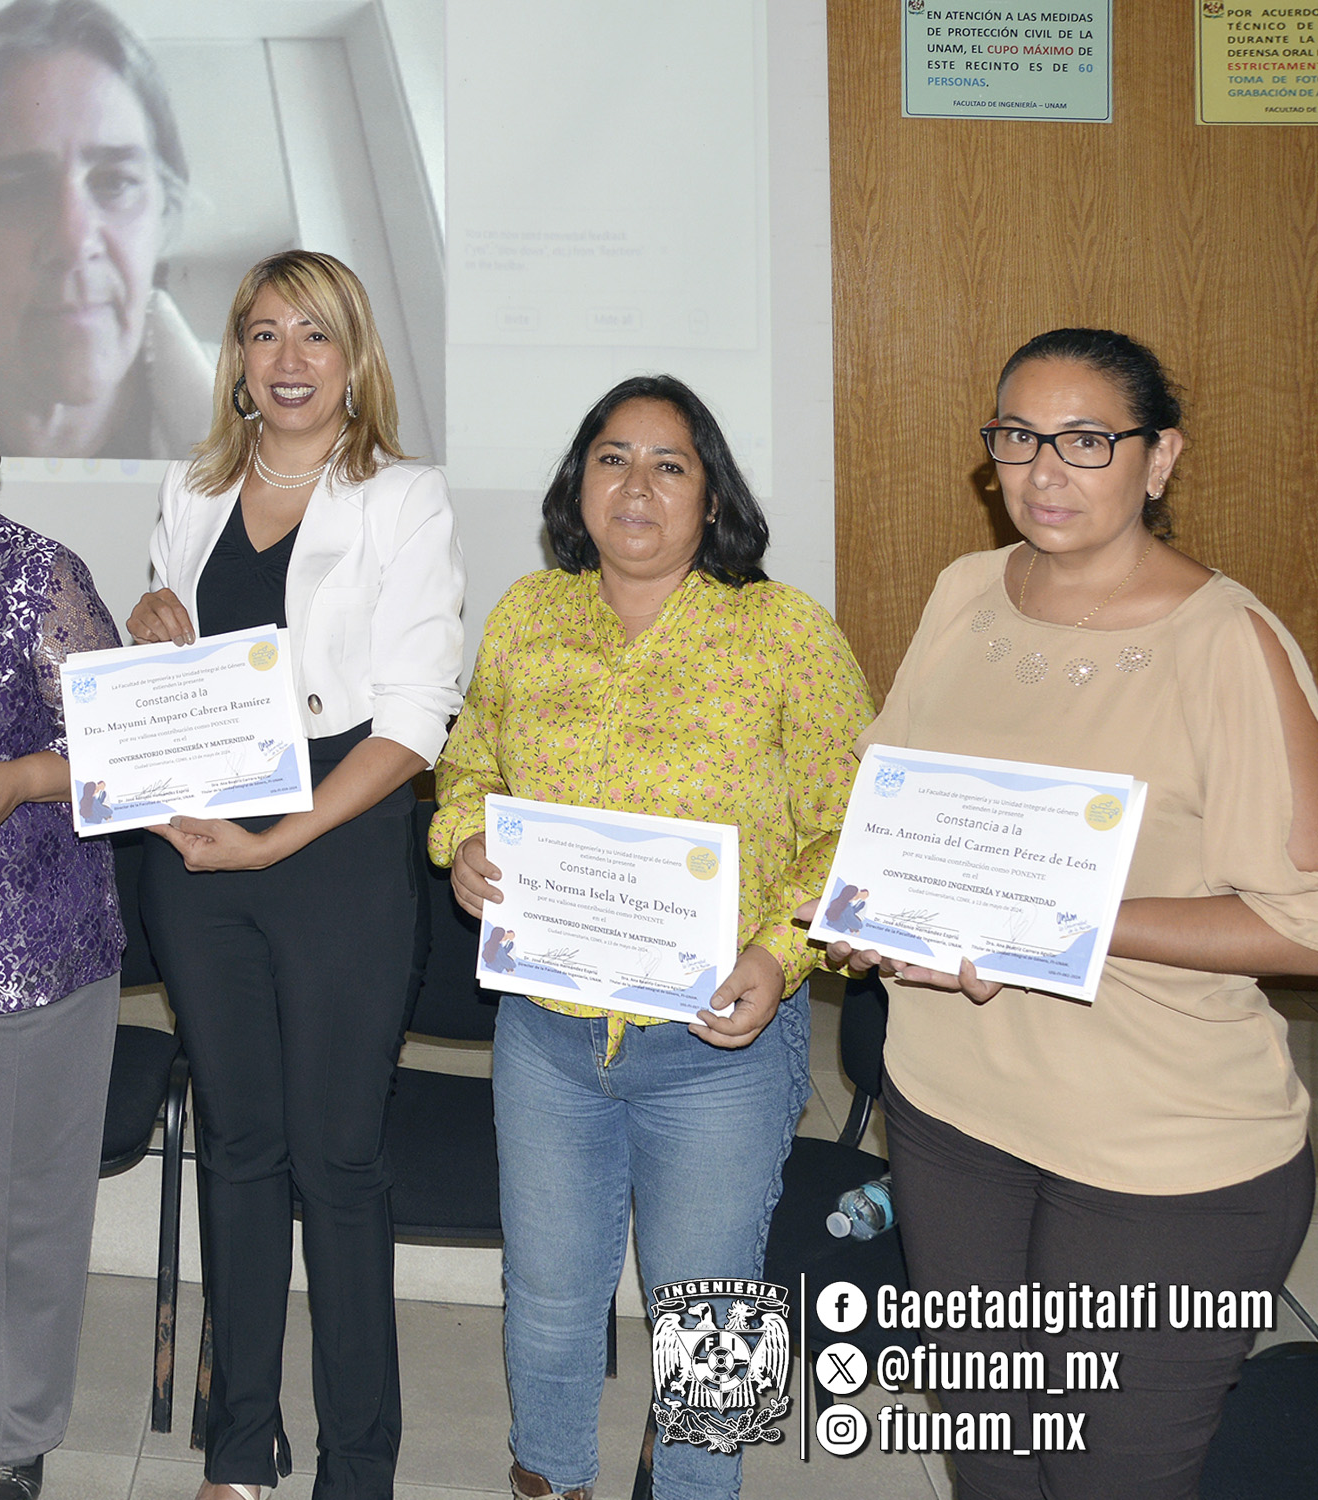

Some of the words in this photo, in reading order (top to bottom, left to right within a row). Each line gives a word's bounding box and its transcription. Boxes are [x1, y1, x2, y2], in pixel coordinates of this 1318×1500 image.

[927, 11, 941, 19] EN
[945, 10, 1002, 21] ATENCIÓN
[1006, 12, 1014, 21] A
[1017, 12, 1037, 21] LAS
[1041, 13, 1093, 23] MEDIDAS
[1227, 21, 1286, 30] TÉCNICO
[1297, 22, 1313, 30] DE
[927, 27, 941, 36] DE
[948, 27, 1018, 38] PROTECCIÓN
[1025, 29, 1052, 38] CIVIL
[1059, 30, 1072, 39] DE
[1080, 31, 1093, 39] LA
[927, 44, 967, 54] UNAM,
[972, 45, 983, 54] EL
[987, 45, 1018, 54] CUPO
[1023, 44, 1074, 55] MÁXIMO
[1079, 47, 1093, 56] DE
[928, 61, 955, 69] ESTE
[966, 62, 1019, 71] RECINTO
[1029, 63, 1042, 72] ES
[1053, 63, 1068, 72] DE
[1079, 64, 1093, 72] 60
[928, 77, 989, 87] PERSONAS.
[1228, 88, 1296, 97] GRABACIÓN
[999, 100, 1038, 108] INGENIERÍA
[135, 691, 189, 709] Constancia
[199, 688, 208, 697] la
[84, 725, 104, 736] Dra.
[107, 718, 146, 733] Mayumi
[150, 710, 187, 726] Amparo
[190, 705, 227, 717] Cabrera
[230, 696, 270, 711] Ramírez
[936, 813, 999, 833] Constancia
[1002, 825, 1008, 833] a
[1012, 823, 1022, 836] la
[864, 822, 893, 836] Mtra.
[896, 828, 941, 845] Antonia
[944, 835, 961, 848] del
[965, 840, 1010, 856] Carmen
[1014, 846, 1045, 863] Pérez
[1049, 853, 1063, 864] de
[1066, 855, 1097, 871] León
[560, 861, 616, 880] Constancia
[619, 874, 625, 882] a
[628, 872, 637, 884] la
[518, 874, 542, 890] Ing.
[545, 880, 586, 896] Norma
[590, 888, 615, 902] Isela
[619, 893, 649, 910] Vega
[653, 900, 697, 919] Deloya
